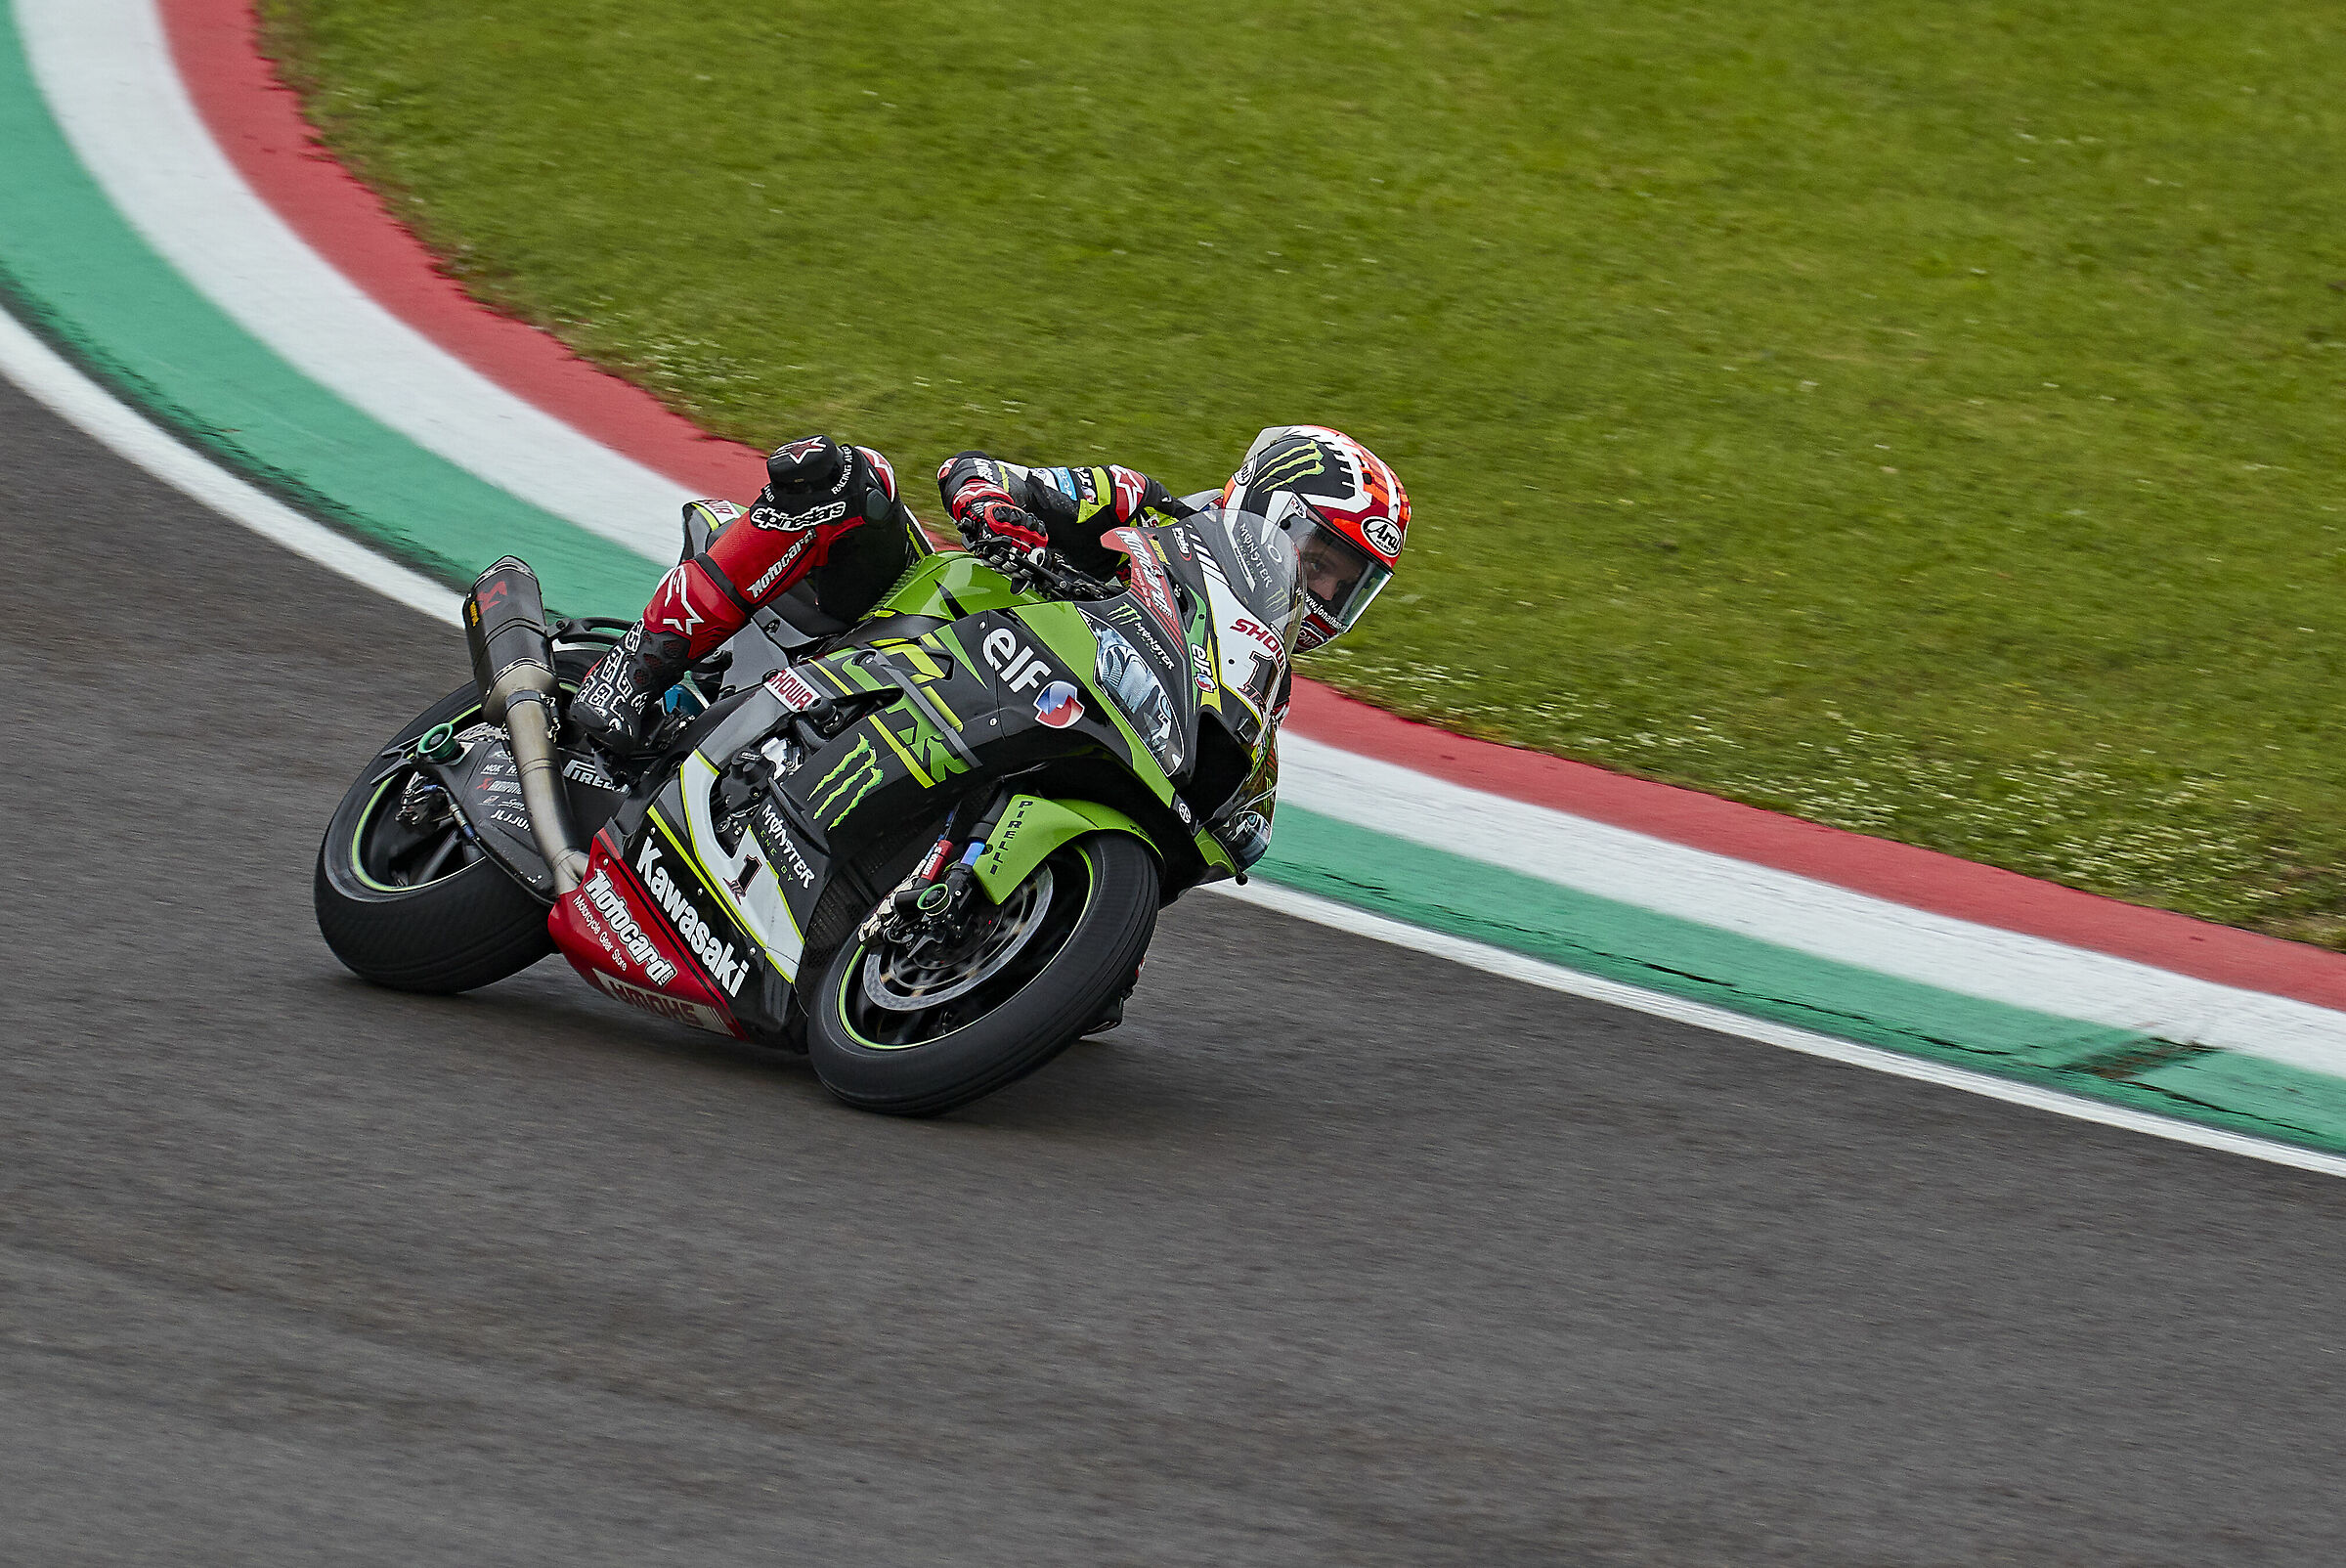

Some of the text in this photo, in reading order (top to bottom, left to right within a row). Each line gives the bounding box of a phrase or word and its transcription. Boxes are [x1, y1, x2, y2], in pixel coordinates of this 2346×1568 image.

[831, 464, 852, 495] RACING
[751, 501, 847, 532] alpinestars
[1366, 523, 1398, 550] Arai
[981, 628, 1052, 693] elf
[1191, 643, 1212, 675] elf
[760, 830, 794, 882] ENEGY
[762, 804, 815, 889] MONSTER
[990, 801, 1033, 875] PIRELLI
[573, 894, 628, 972] Motorcycle Gear Store
[636, 836, 750, 998] Kawasaki
